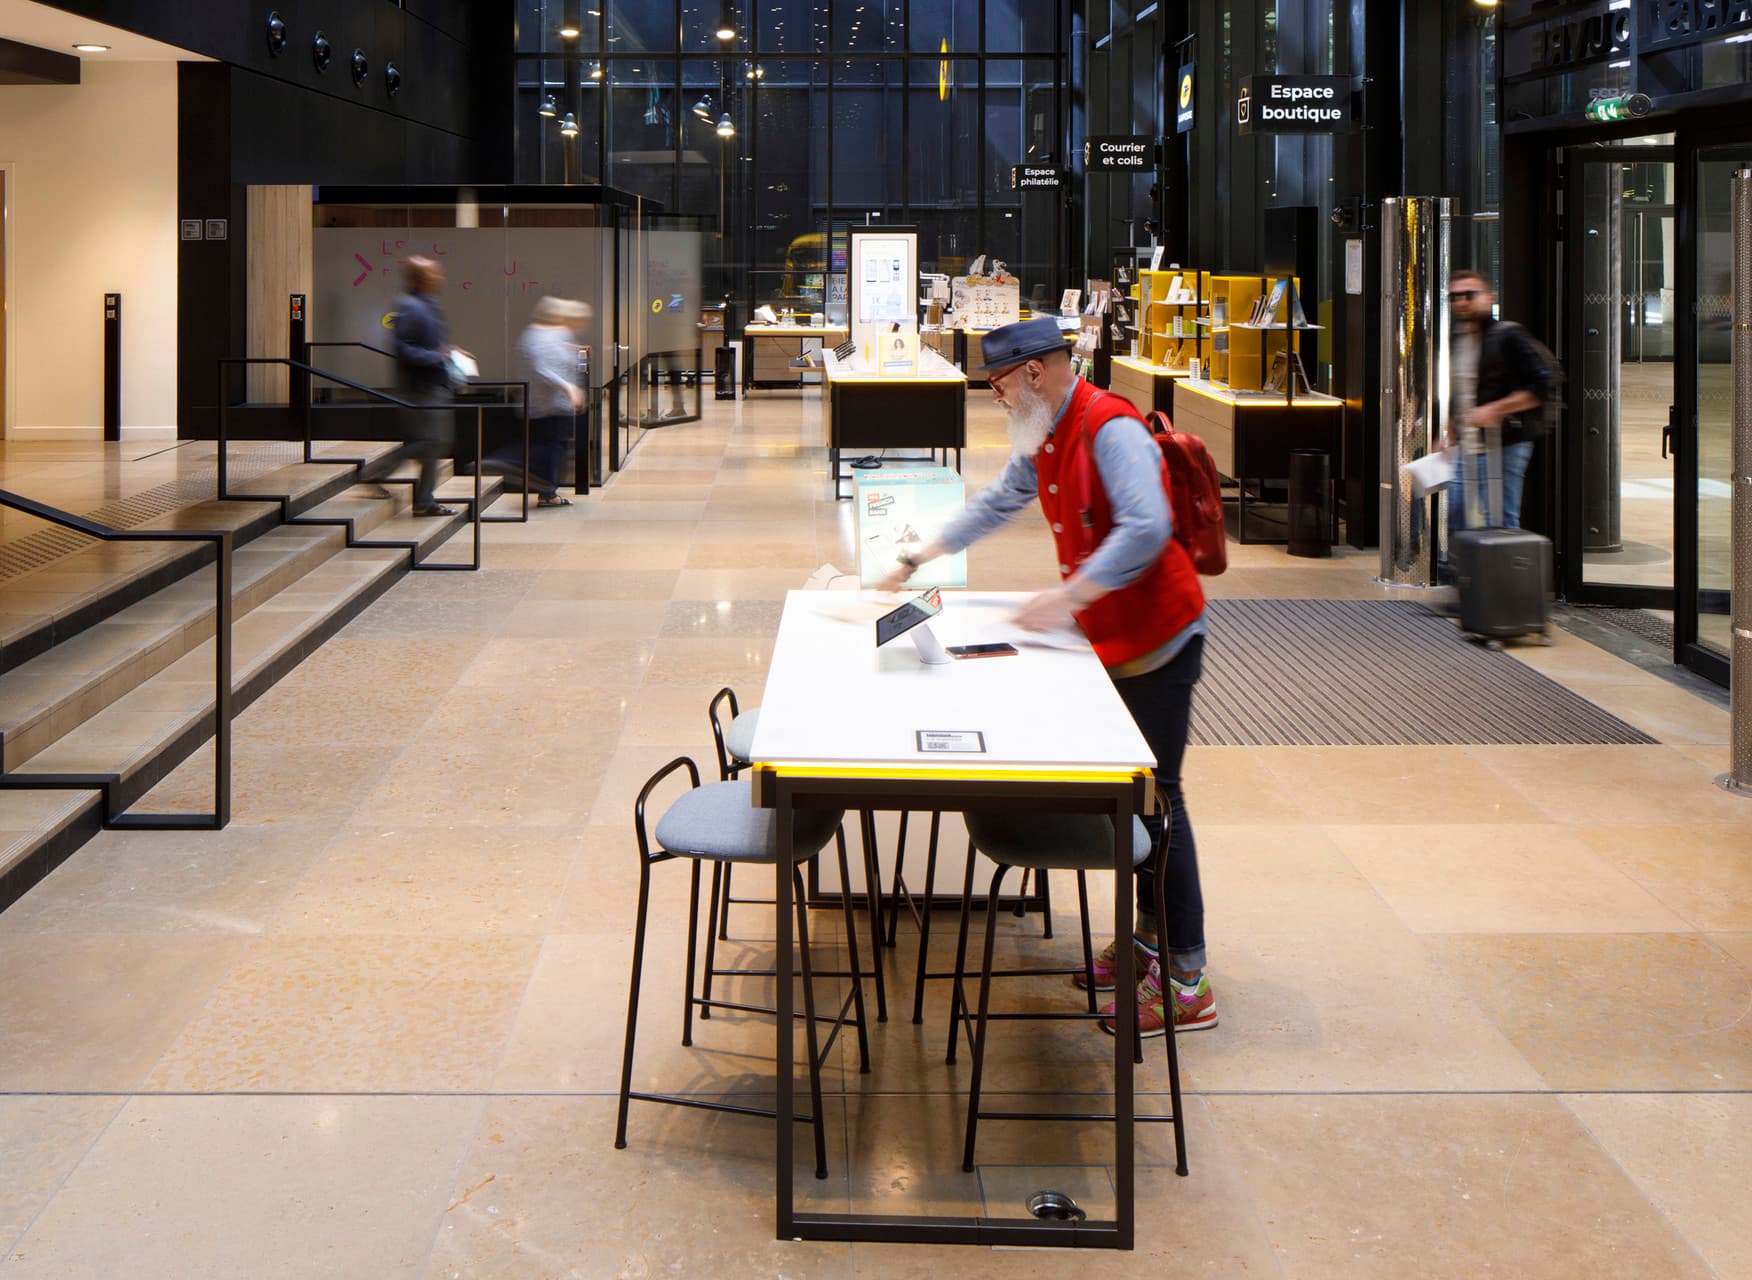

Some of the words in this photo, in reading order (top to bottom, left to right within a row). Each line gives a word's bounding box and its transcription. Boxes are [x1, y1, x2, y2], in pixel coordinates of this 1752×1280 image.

[1270, 84, 1335, 102] Espace
[1262, 105, 1342, 123] boutique
[1099, 142, 1146, 153] Courrier
[1102, 155, 1115, 165] et
[1117, 155, 1144, 165] colis
[1024, 168, 1056, 178] Espace
[1020, 177, 1060, 187] philatélie
